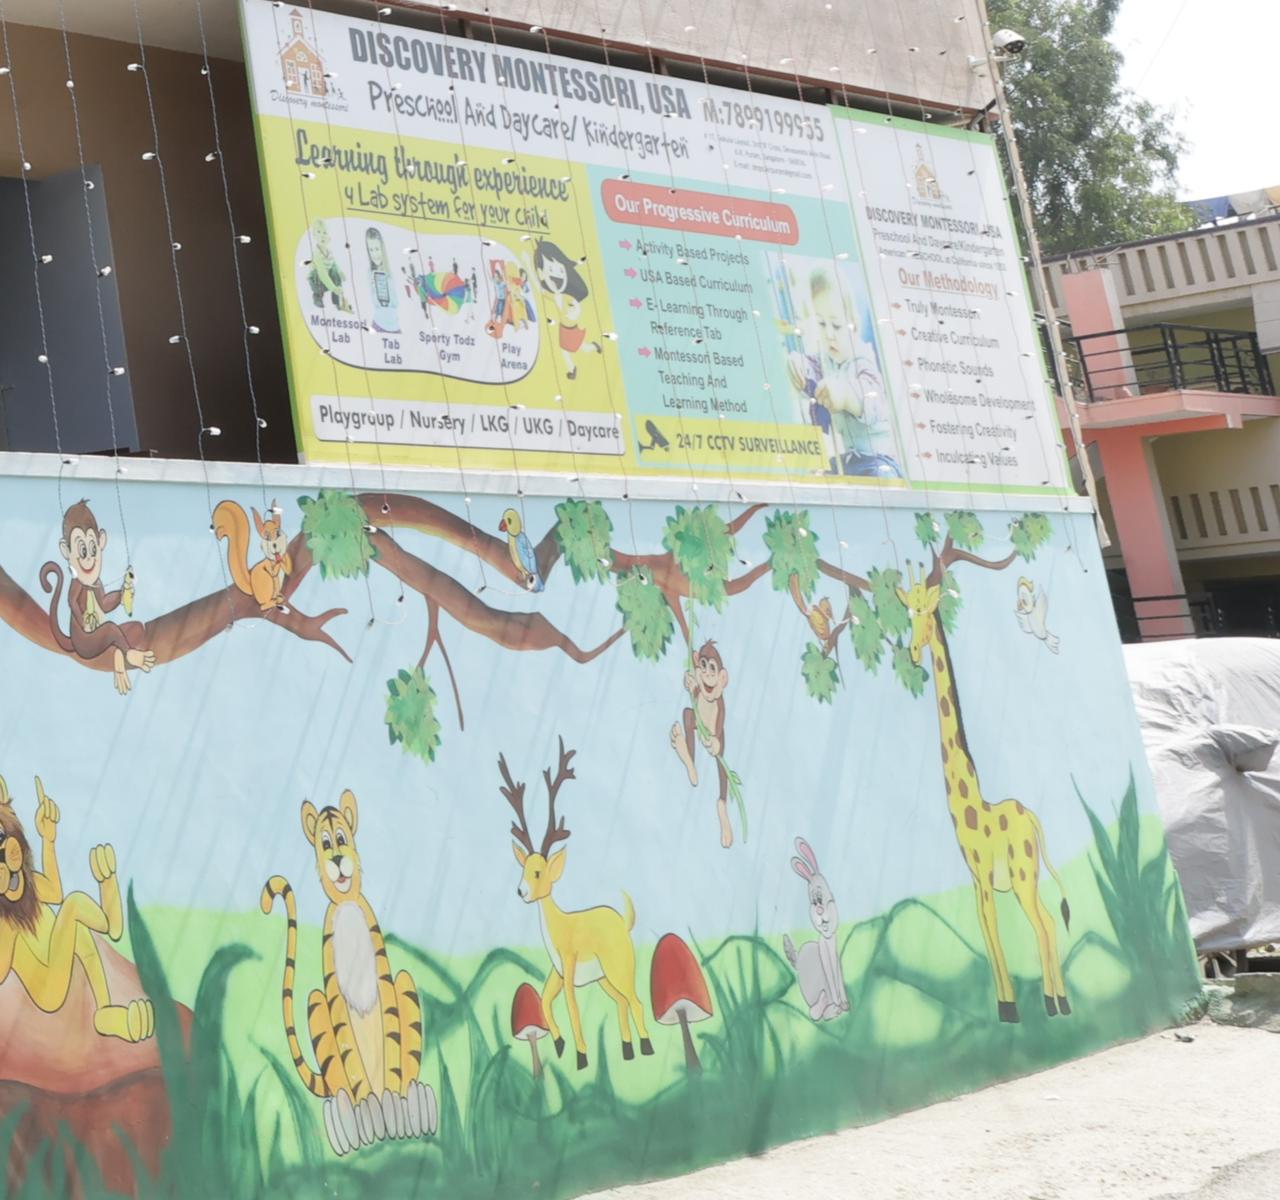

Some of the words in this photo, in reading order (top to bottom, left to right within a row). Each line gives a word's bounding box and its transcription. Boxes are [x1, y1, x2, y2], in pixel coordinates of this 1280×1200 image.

[348, 27, 486, 84] DISCOVERY
[492, 53, 645, 115] MONTESSORI,
[646, 82, 692, 120] USA
[368, 80, 458, 124] Preschool
[465, 97, 496, 128] And
[501, 103, 577, 142] Daycare/
[583, 116, 689, 159] Kindergarten
[296, 128, 388, 185] Learning
[394, 145, 469, 194] through
[474, 166, 570, 201] experience
[358, 182, 388, 208] Lab
[394, 192, 449, 219] system
[481, 203, 509, 226] your
[615, 194, 640, 213] Our
[643, 202, 720, 225] Progressive
[722, 209, 791, 234] Curriculum
[865, 206, 918, 227] DISCOVERY
[636, 239, 674, 259] Activity
[675, 244, 707, 260] Based
[710, 248, 750, 266] Projects
[640, 270, 662, 284] USA
[665, 272, 697, 288] Based
[699, 275, 753, 294] Curriculum
[898, 267, 920, 285] Our
[923, 270, 998, 300] Methodology
[660, 301, 705, 320] Learning
[706, 304, 748, 323] Through
[905, 299, 928, 317] Truly
[331, 331, 351, 343] Lab
[419, 331, 451, 346] Sporty
[453, 334, 476, 346] Todz
[650, 321, 703, 339] Reference
[703, 326, 722, 341] Tab
[911, 327, 949, 343] Creative
[950, 331, 999, 348] Curriculum
[382, 338, 400, 350] Tab
[502, 342, 522, 357] Play
[384, 353, 402, 365] Lab
[439, 350, 461, 362] Gym
[500, 358, 528, 370] Arena
[654, 347, 711, 364] Montessori
[713, 352, 744, 367] Based
[917, 357, 957, 374] Phonetic
[959, 361, 994, 377] Sounds
[658, 370, 705, 390] Teaching
[707, 375, 727, 389] And
[662, 395, 708, 413] Learning
[710, 397, 748, 413] Method
[924, 390, 978, 406] Wholesome
[978, 393, 1035, 411] Development
[320, 404, 395, 430] Playgroup
[410, 410, 465, 435] Nursery
[480, 414, 509, 433] LKG
[523, 417, 553, 436] UKG
[567, 419, 619, 442] Daycare
[930, 420, 974, 439] Fostering
[975, 423, 1016, 441] Creativity
[676, 433, 703, 449] 24/7
[707, 434, 735, 450] CCTV
[739, 437, 822, 455] SURVEILLANCE
[989, 453, 1018, 466] Values
